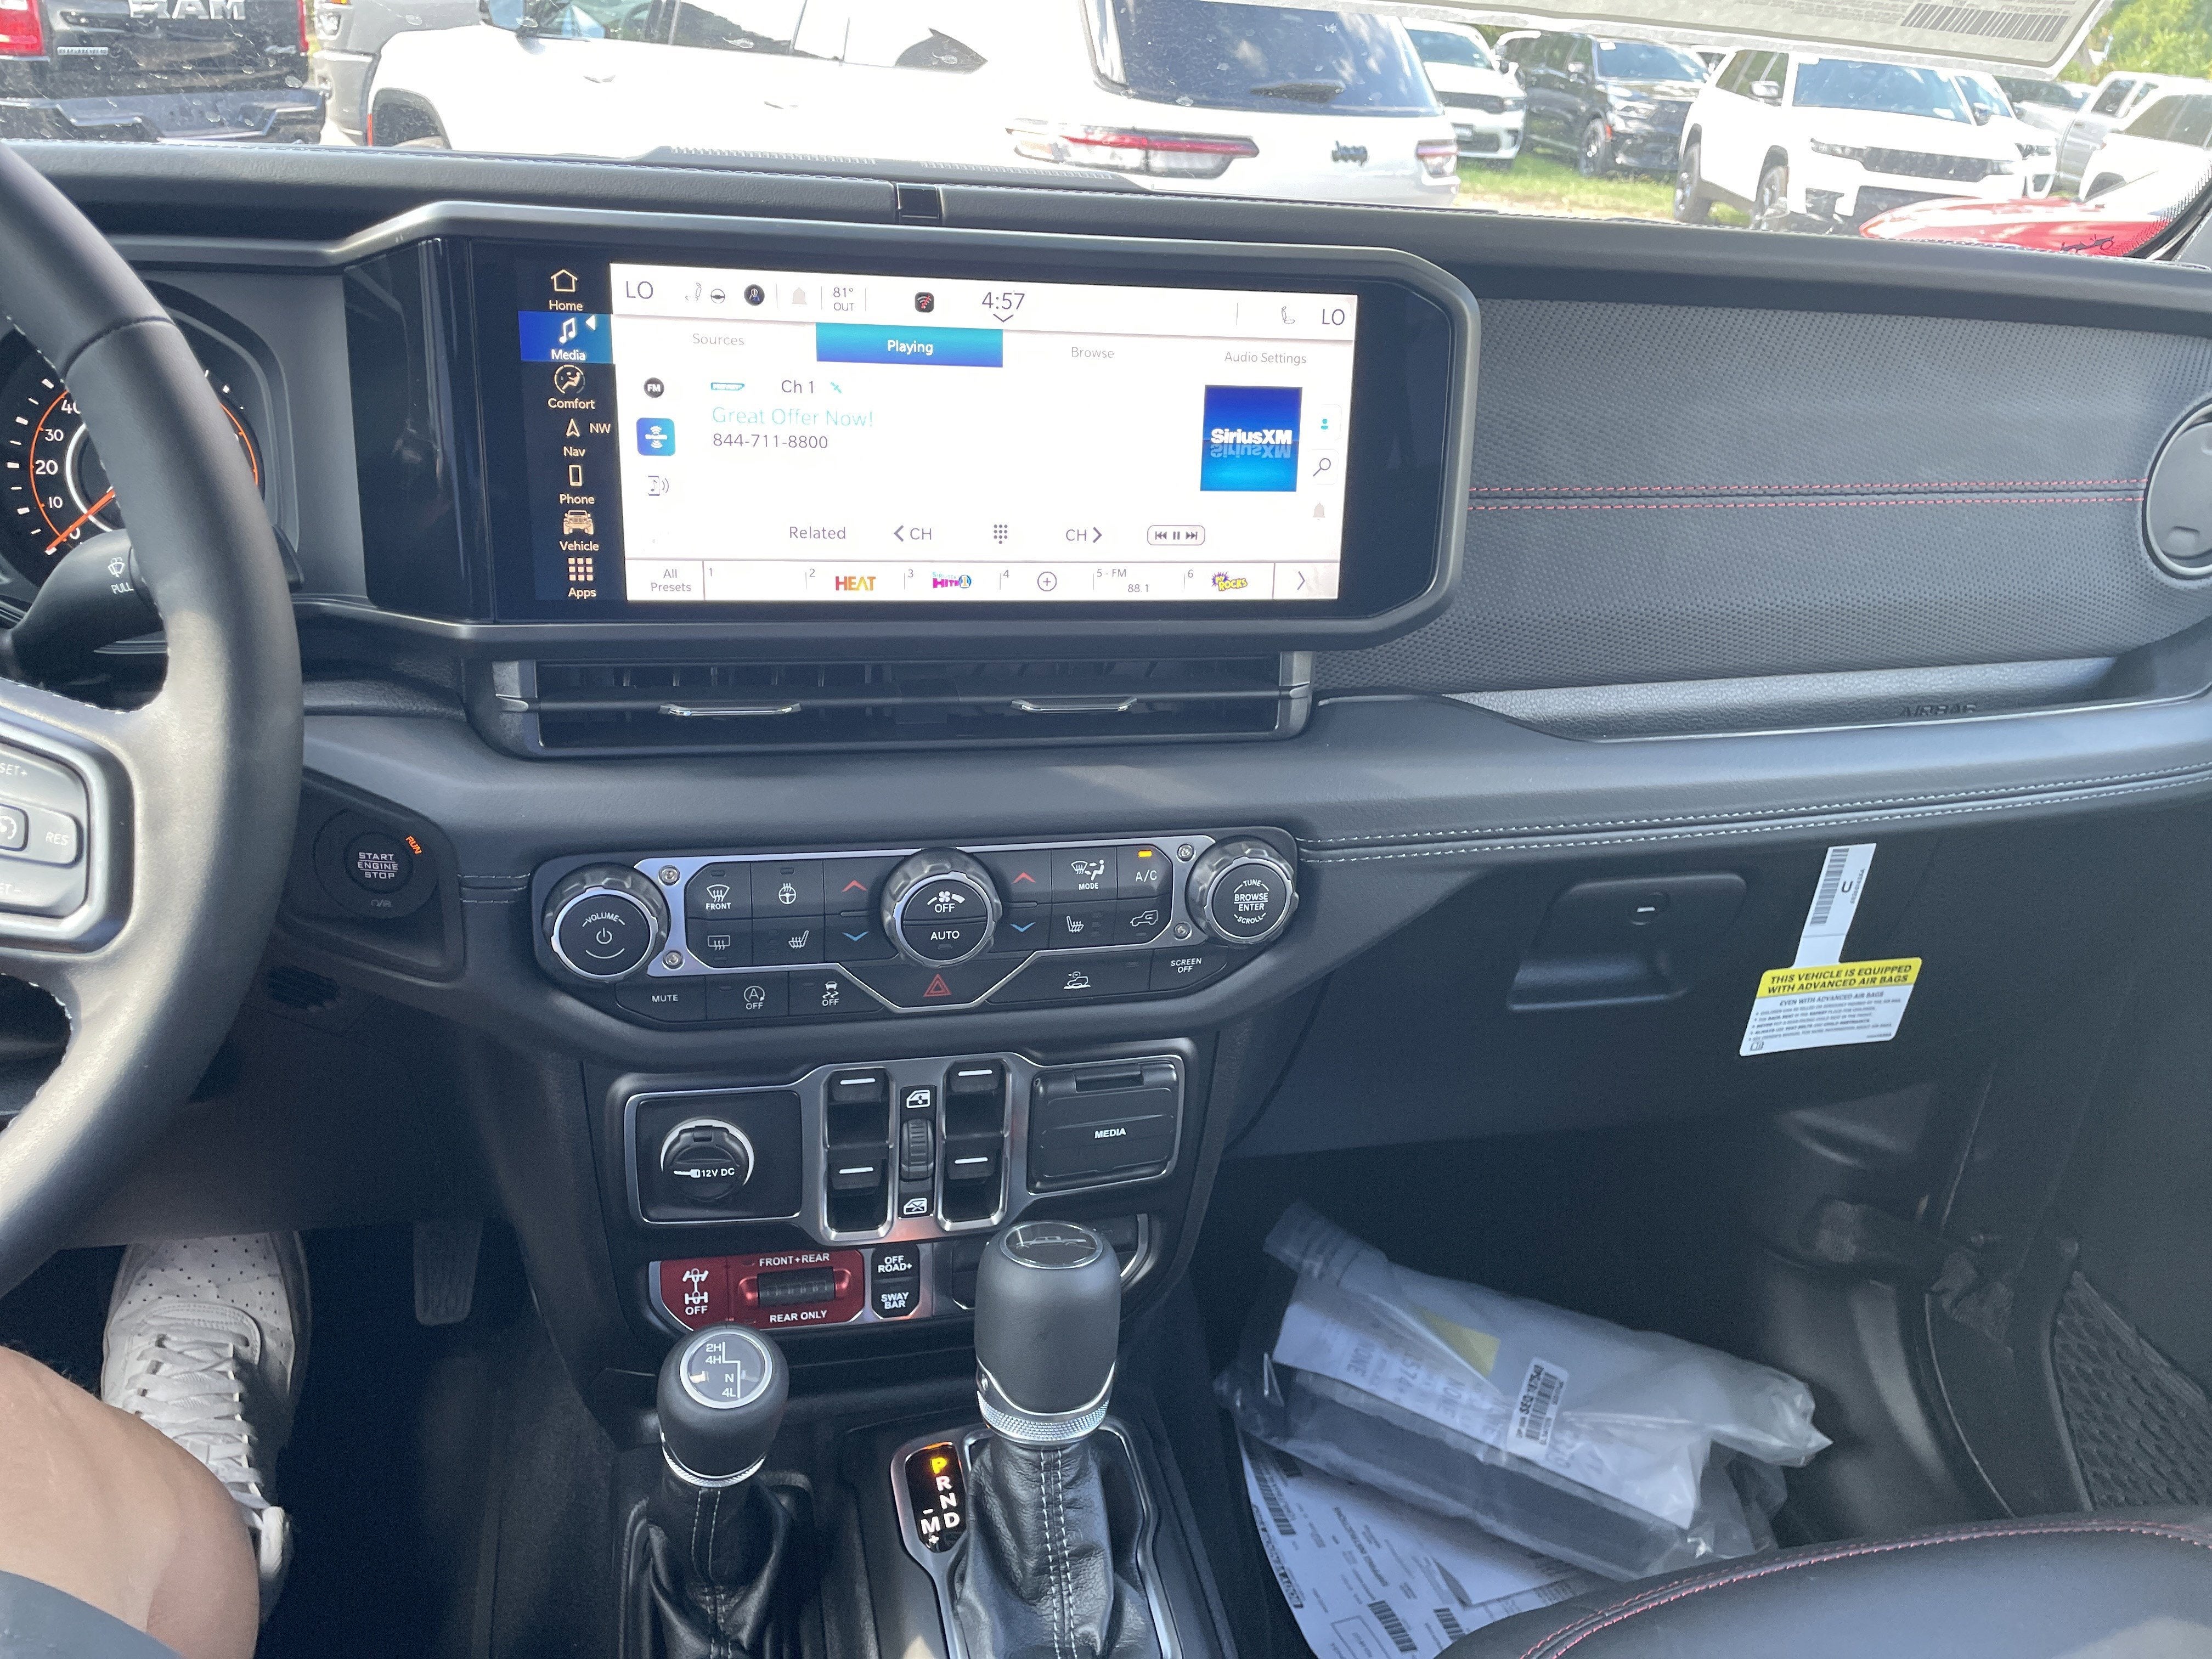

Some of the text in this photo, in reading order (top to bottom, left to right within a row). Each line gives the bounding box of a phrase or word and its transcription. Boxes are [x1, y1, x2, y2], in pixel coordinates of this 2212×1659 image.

[626, 280, 653, 299] LO
[549, 300, 583, 312] Home
[833, 302, 855, 312] OUT
[981, 292, 1025, 310] 4:57
[1322, 309, 1345, 325] LO
[692, 332, 745, 346] Sources
[887, 340, 933, 356] Playing
[1071, 347, 1115, 359] Browse
[551, 349, 586, 361] Media
[1224, 351, 1307, 366] Audio Settings
[647, 384, 661, 392] FM
[781, 381, 815, 393] Ch 1
[548, 398, 595, 410] Comfort
[713, 407, 873, 427] Great Offer Now!
[45, 428, 64, 442] 30
[589, 424, 611, 434] NW
[713, 433, 828, 449] 844-711-8800
[1210, 428, 1293, 445] SiriusXM
[563, 446, 586, 458] Nav
[35, 460, 58, 475] 20
[48, 496, 63, 509] 10
[559, 494, 595, 506] Phone
[789, 526, 846, 540] Related
[910, 528, 932, 540] CH
[1065, 529, 1087, 541] CH
[559, 541, 600, 552] Vehicle
[663, 569, 678, 579] All
[708, 568, 713, 577] 1
[809, 568, 816, 578] 2
[907, 569, 914, 578] 3
[1003, 569, 1010, 578] 4
[1097, 568, 1103, 578] 5
[1111, 568, 1127, 578] FM
[1188, 569, 1194, 579] 6
[111, 582, 134, 594] PULL
[651, 582, 692, 592] Presets
[835, 575, 876, 591] HEAT
[1127, 584, 1149, 593] 88.1
[1218, 578, 1248, 591] ROCKS
[567, 587, 596, 599] Apps
[46, 832, 69, 846] RES
[405, 836, 422, 855] RUN
[358, 852, 395, 861] START
[357, 861, 398, 871] ENGINE
[364, 871, 395, 879] STOP
[1134, 870, 1158, 882] A/C
[1242, 879, 1262, 888] TUNE
[1233, 893, 1269, 904] BROWSE
[705, 901, 731, 911] FRONT
[934, 902, 956, 913] OFF
[1237, 902, 1265, 912] ENTER
[585, 911, 620, 924] VOLUME
[1236, 913, 1264, 925] SCROLL
[930, 929, 961, 940] AUTO
[1170, 957, 1203, 968] SCREEN
[1177, 964, 1194, 974] OFF
[1771, 964, 1912, 985] THIS VEHICLE IS EQUIPPED
[1768, 974, 1909, 995] WITH ADVANCED AIR BAGS
[651, 994, 679, 1003] MUTE
[821, 997, 839, 1006] OFF
[745, 1001, 764, 1010] OFF
[1093, 1126, 1127, 1139] MEDIA
[702, 1167, 735, 1177] 12V DC
[884, 1255, 904, 1265] OFF
[878, 1262, 913, 1273] ROAD+
[881, 1291, 909, 1303] SWAY
[685, 1305, 708, 1316] OFF
[884, 1299, 906, 1310] BAR
[770, 1310, 828, 1323] REAR ONLY
[706, 1343, 721, 1352] 2H
[705, 1355, 722, 1365] 4H
[725, 1373, 735, 1383] N
[721, 1387, 737, 1398] 4L
[931, 1457, 947, 1475] P
[935, 1475, 952, 1491] R
[939, 1492, 957, 1509] N
[921, 1516, 941, 1534] M
[943, 1511, 961, 1528] D
